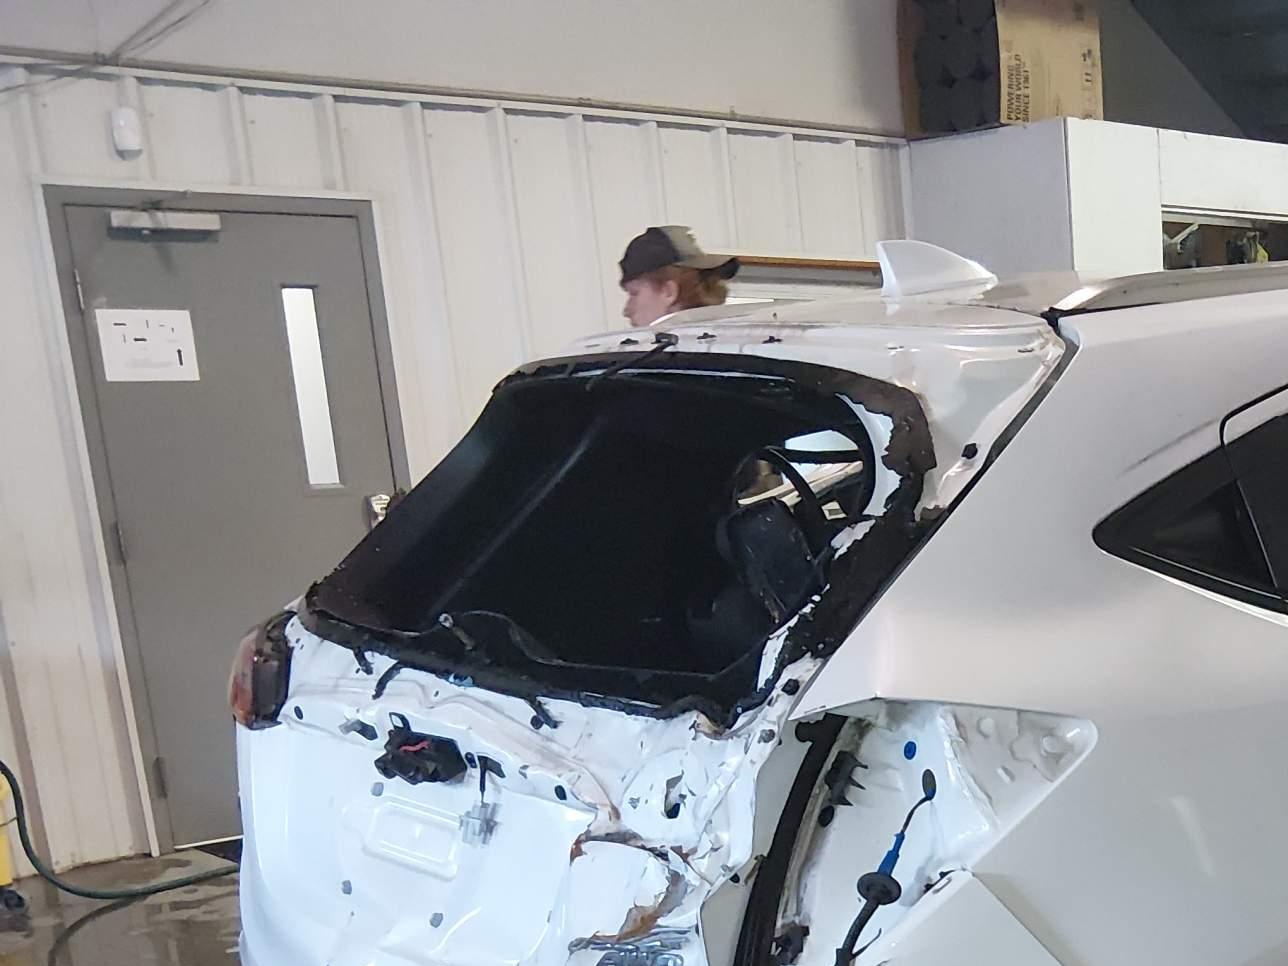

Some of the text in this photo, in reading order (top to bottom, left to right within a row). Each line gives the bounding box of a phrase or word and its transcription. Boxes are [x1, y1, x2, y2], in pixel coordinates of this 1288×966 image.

[1007, 65, 1015, 121] POWERING
[1014, 54, 1022, 122] YOUR WORLD
[1022, 93, 1030, 123] SINCE
